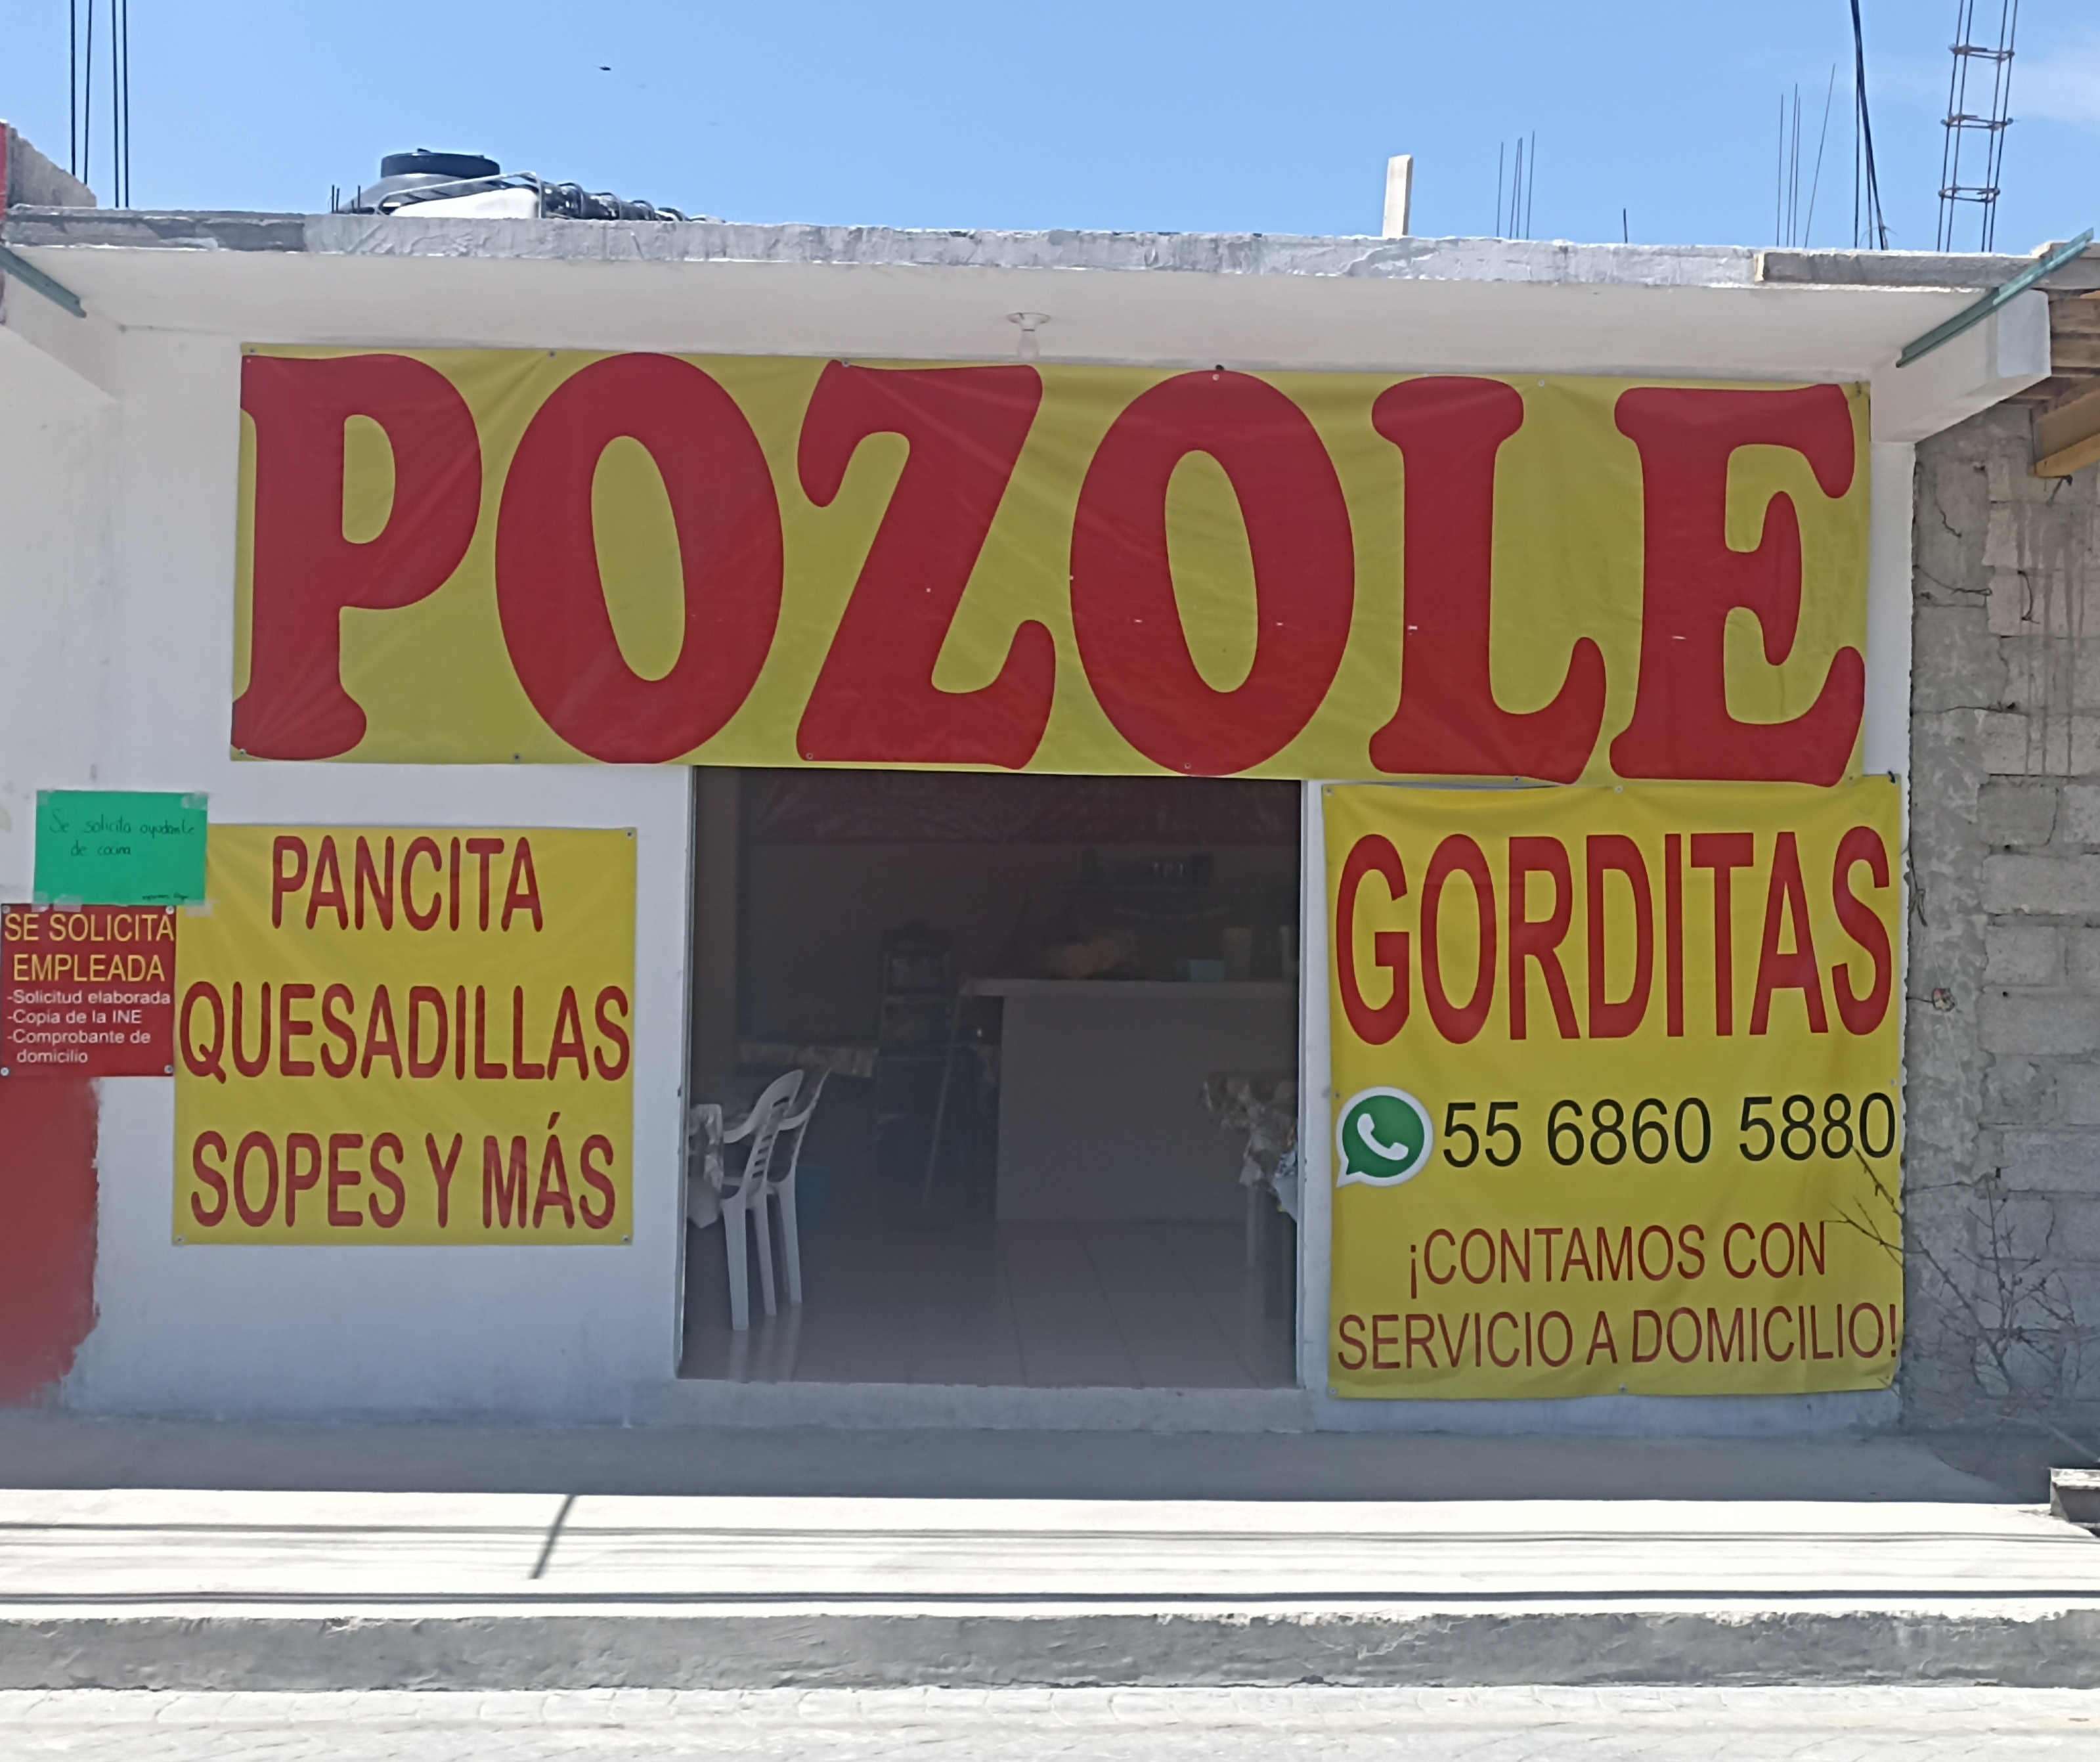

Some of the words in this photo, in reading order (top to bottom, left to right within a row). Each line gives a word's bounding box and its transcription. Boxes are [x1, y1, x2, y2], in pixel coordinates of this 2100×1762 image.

[232, 353, 1866, 787] POZOLE
[49, 808, 70, 833] Se
[83, 814, 131, 833] solicita
[71, 839, 87, 856] de
[273, 835, 544, 932] PANCITA
[5, 913, 39, 942] SE
[49, 913, 175, 942] SOLICITA
[1336, 826, 1892, 1046] GORDITAS
[13, 954, 165, 982] EMPLEADA
[66, 1009, 86, 1023] de
[92, 1009, 106, 1023] la
[112, 1010, 142, 1023] INE
[88, 990, 171, 1005] elaborada
[16, 1049, 88, 1063] domicilio
[130, 1029, 150, 1044] de
[179, 981, 630, 1084] QUESADILLAS
[1443, 1101, 1521, 1168] 55
[1546, 1097, 1711, 1166] 6860
[1739, 1092, 1896, 1162] 5880
[191, 1130, 406, 1228] SOPES
[425, 1133, 462, 1227] Y
[483, 1112, 615, 1229] MÁS
[1409, 1225, 1706, 1299] ¡CONTAMOS
[1723, 1222, 1826, 1279] CON
[1337, 1311, 1573, 1370] SERVICIO
[1586, 1311, 1618, 1365] A
[1631, 1303, 1898, 1364] DOMICILIO!
